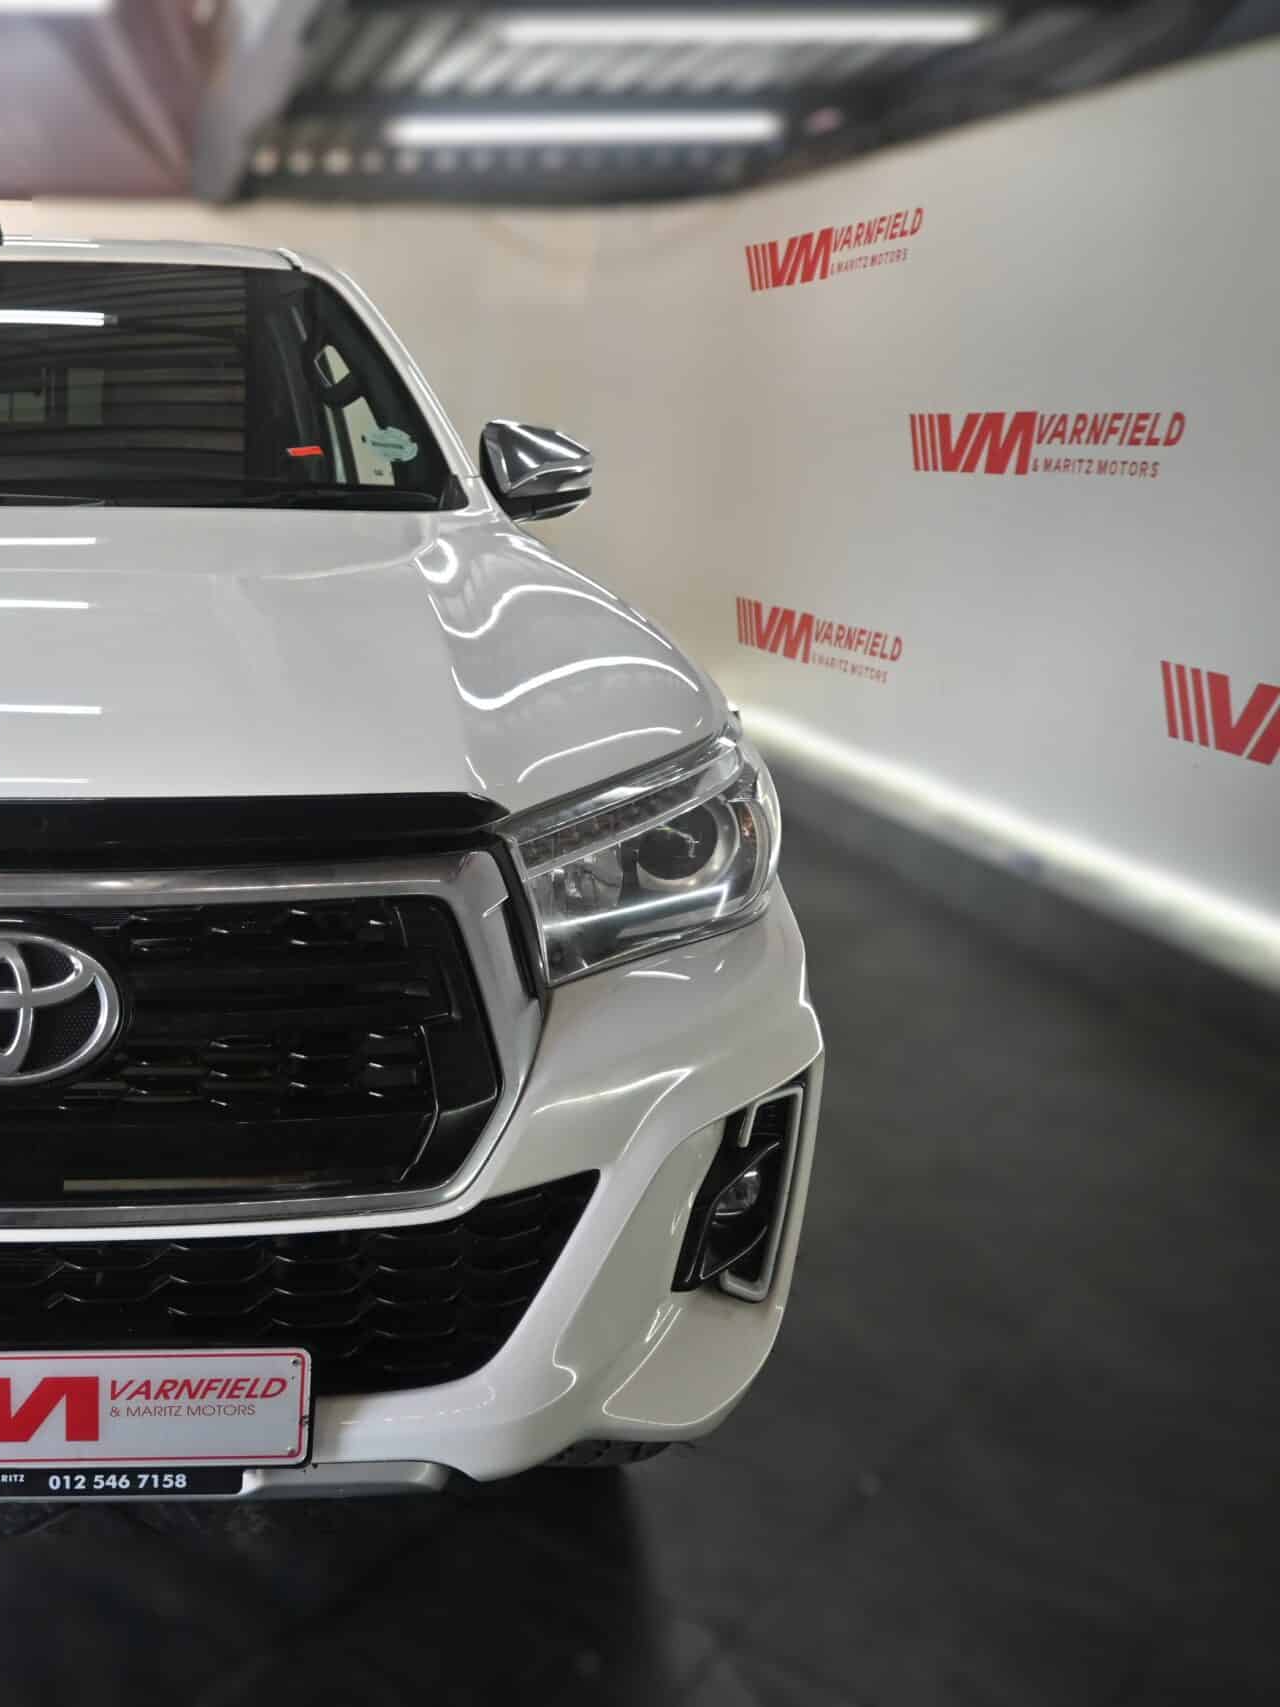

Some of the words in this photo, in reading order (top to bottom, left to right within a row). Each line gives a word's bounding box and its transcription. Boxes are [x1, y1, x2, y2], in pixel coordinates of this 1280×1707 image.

[832, 207, 924, 252] VARNFIELD
[769, 228, 834, 288] VM
[870, 248, 908, 267] MOTORS
[938, 411, 1037, 475] VM
[1036, 412, 1186, 447] VARNFIELD
[1043, 458, 1094, 475] MARITZ
[1096, 460, 1160, 478] MOTORS
[754, 601, 815, 664] VM
[815, 618, 903, 662] VARNFIELD
[110, 1377, 287, 1401] VARNFIELD
[110, 1406, 121, 1418] &
[126, 1405, 182, 1417] MARITZ
[186, 1404, 256, 1417] MOTORS
[48, 1475, 86, 1490] 012
[92, 1474, 130, 1489] 546
[137, 1474, 187, 1489] 7158
